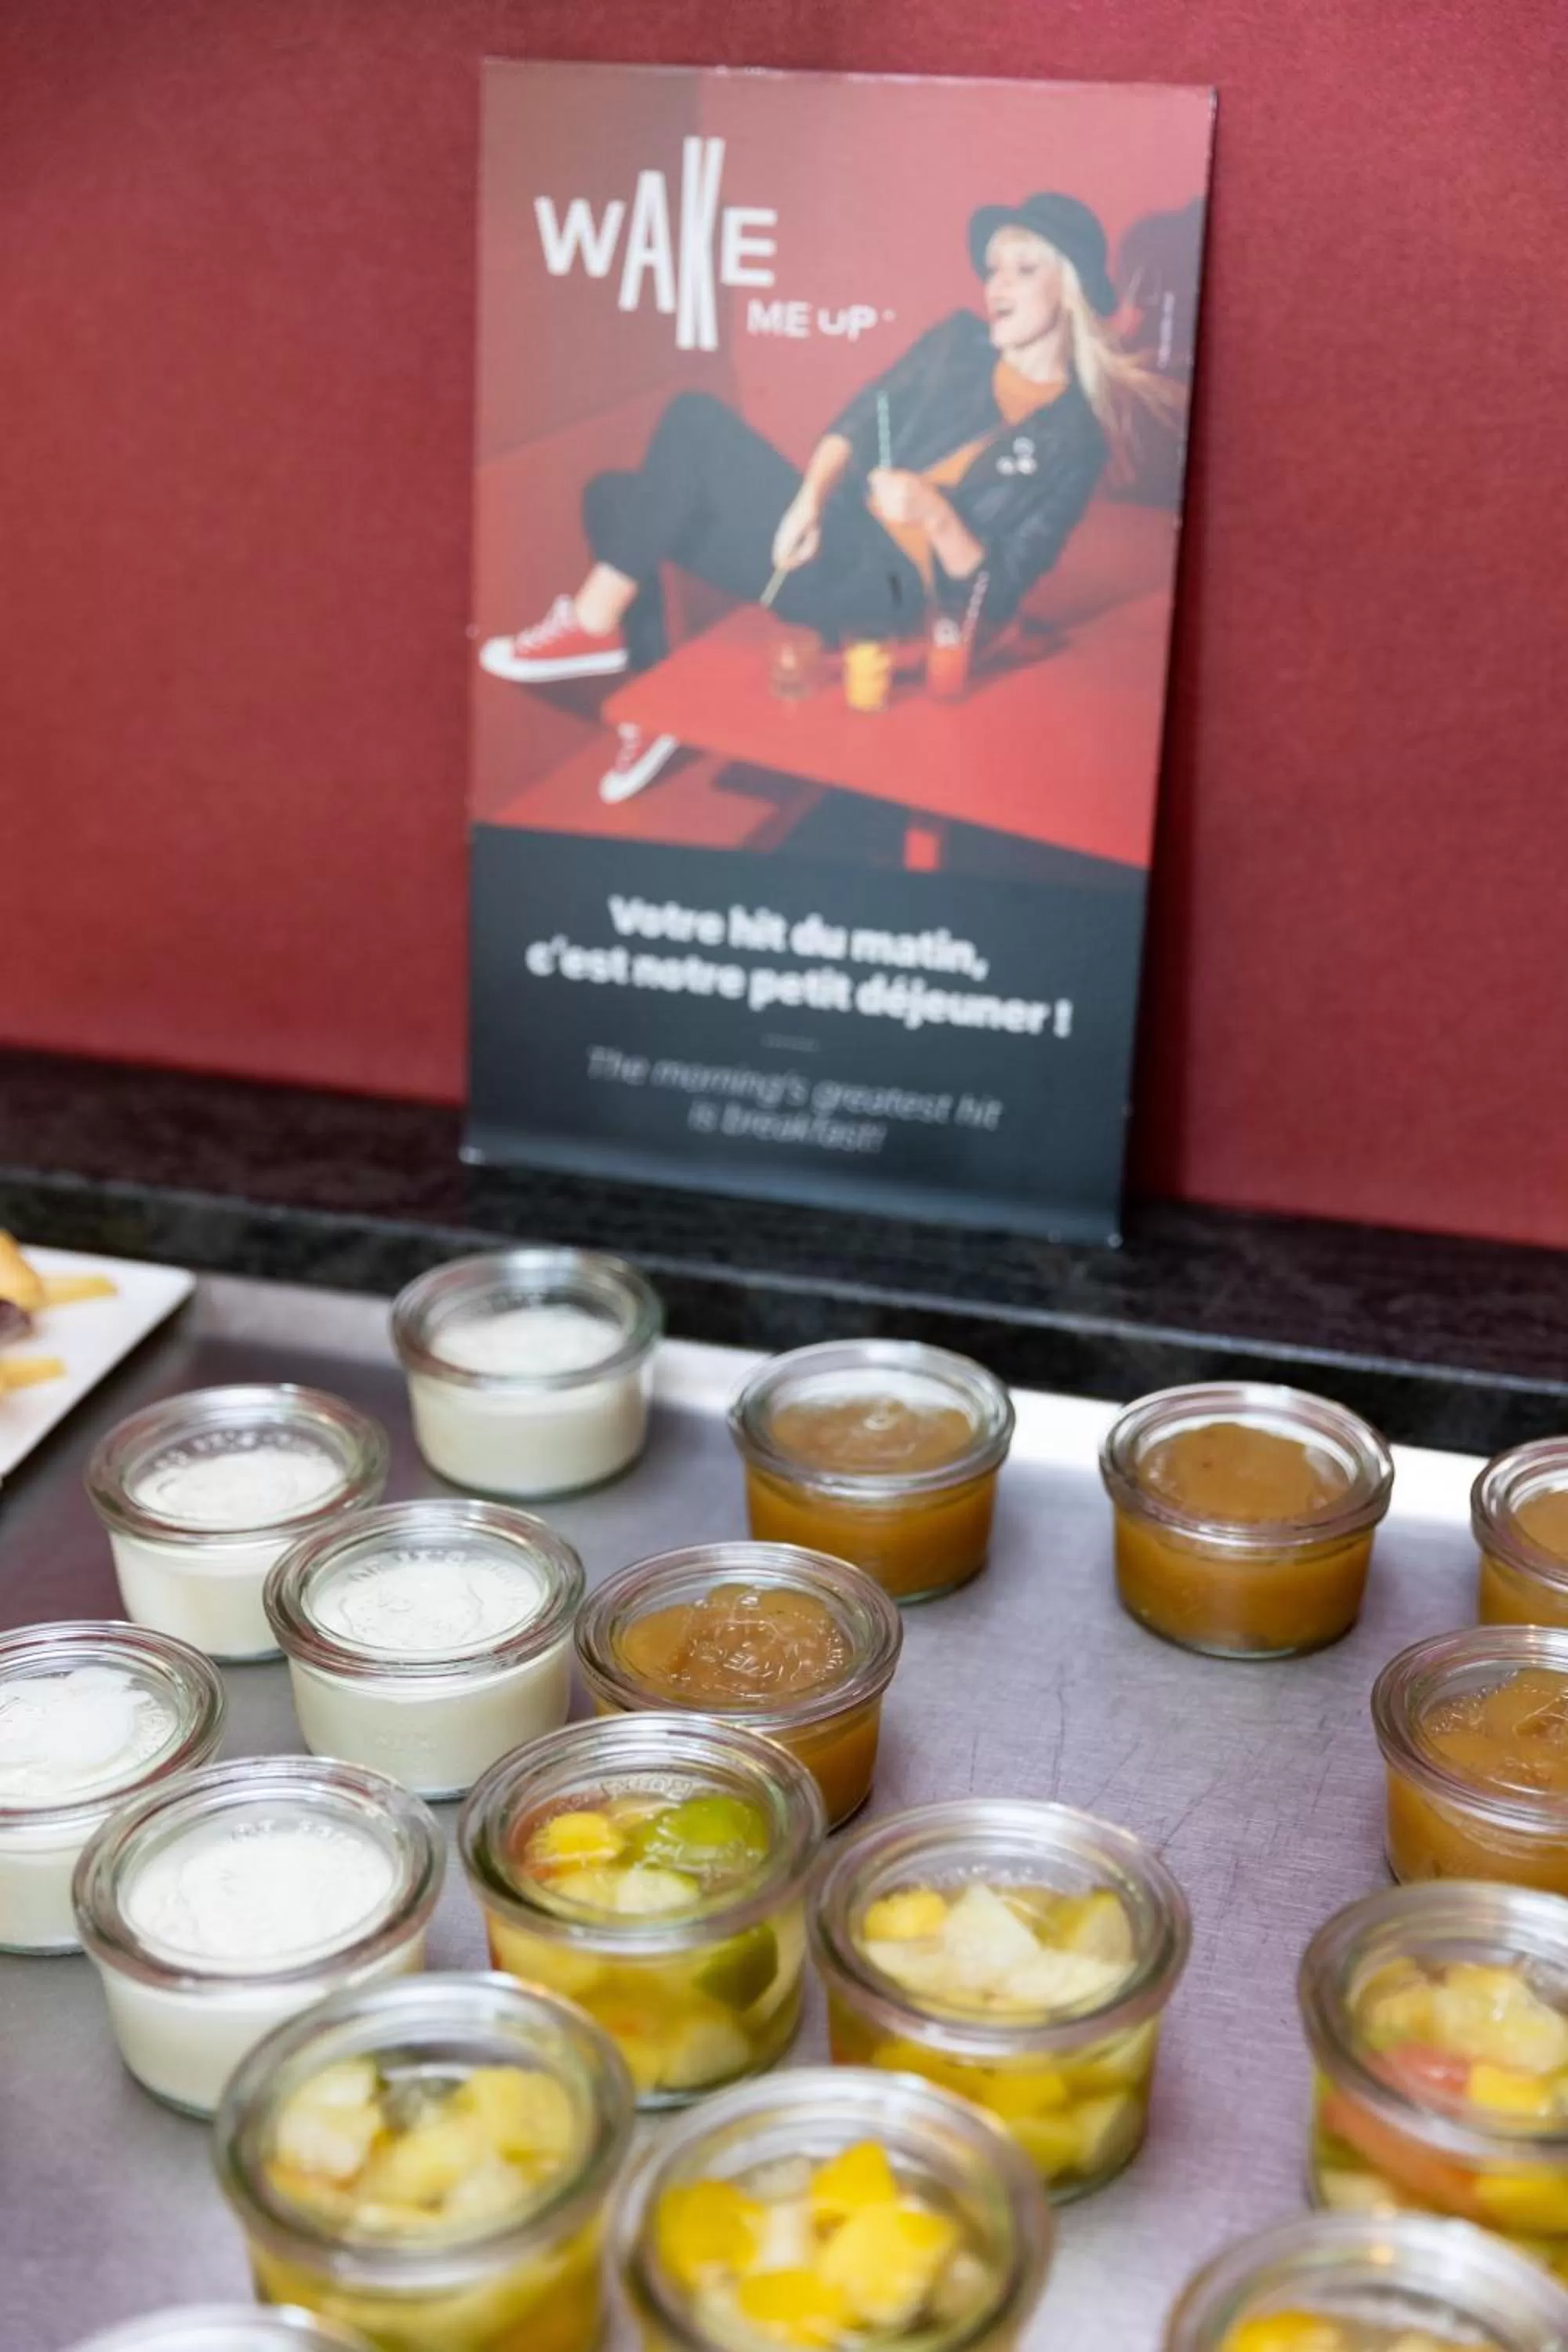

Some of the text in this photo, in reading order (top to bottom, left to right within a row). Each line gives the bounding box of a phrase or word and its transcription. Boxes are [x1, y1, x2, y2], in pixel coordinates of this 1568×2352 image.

[532, 135, 778, 351] WAKE
[746, 299, 812, 338] ME
[607, 894, 990, 982] Votre hit du matin,
[524, 933, 629, 985] c'est
[630, 953, 746, 1000] notre
[746, 966, 852, 1012] petit
[855, 971, 1050, 1035] déjeuner
[586, 1044, 650, 1087] The
